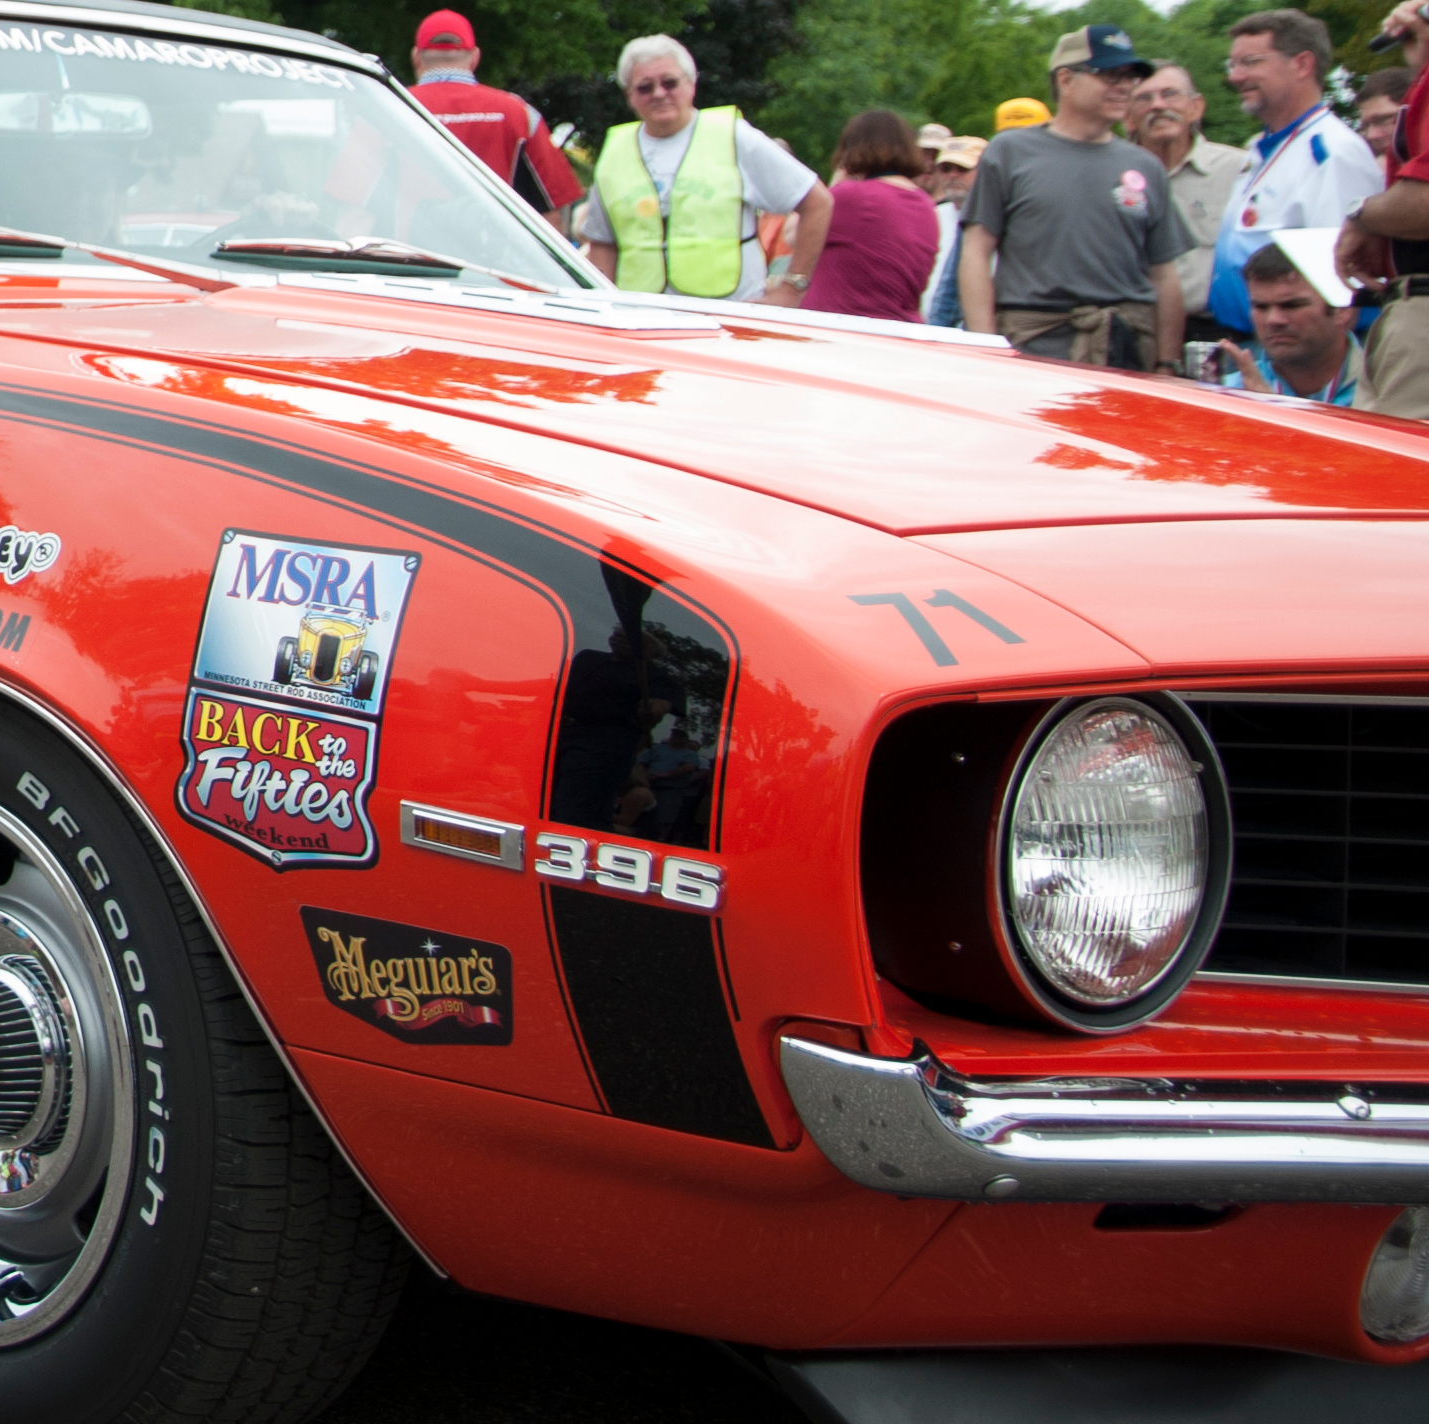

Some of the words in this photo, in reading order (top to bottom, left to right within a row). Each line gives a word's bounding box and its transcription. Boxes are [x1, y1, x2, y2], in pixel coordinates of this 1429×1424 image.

[227, 543, 379, 620] MSRA
[846, 588, 1026, 667] 71
[204, 670, 251, 687] MINNESOTA
[252, 680, 286, 693] STREET
[286, 686, 305, 698] ROD
[306, 690, 366, 710] ASSOCIATION
[195, 700, 321, 764] BACK
[318, 733, 347, 755] to
[315, 754, 356, 778] the
[196, 746, 354, 829] Fifties
[224, 813, 330, 851] weekend
[535, 831, 726, 910] 396
[16, 771, 171, 1227] BFGoodrich
[317, 926, 498, 1022] Meguiar's
[422, 1005, 442, 1021] Since
[442, 1001, 465, 1014] 1901
